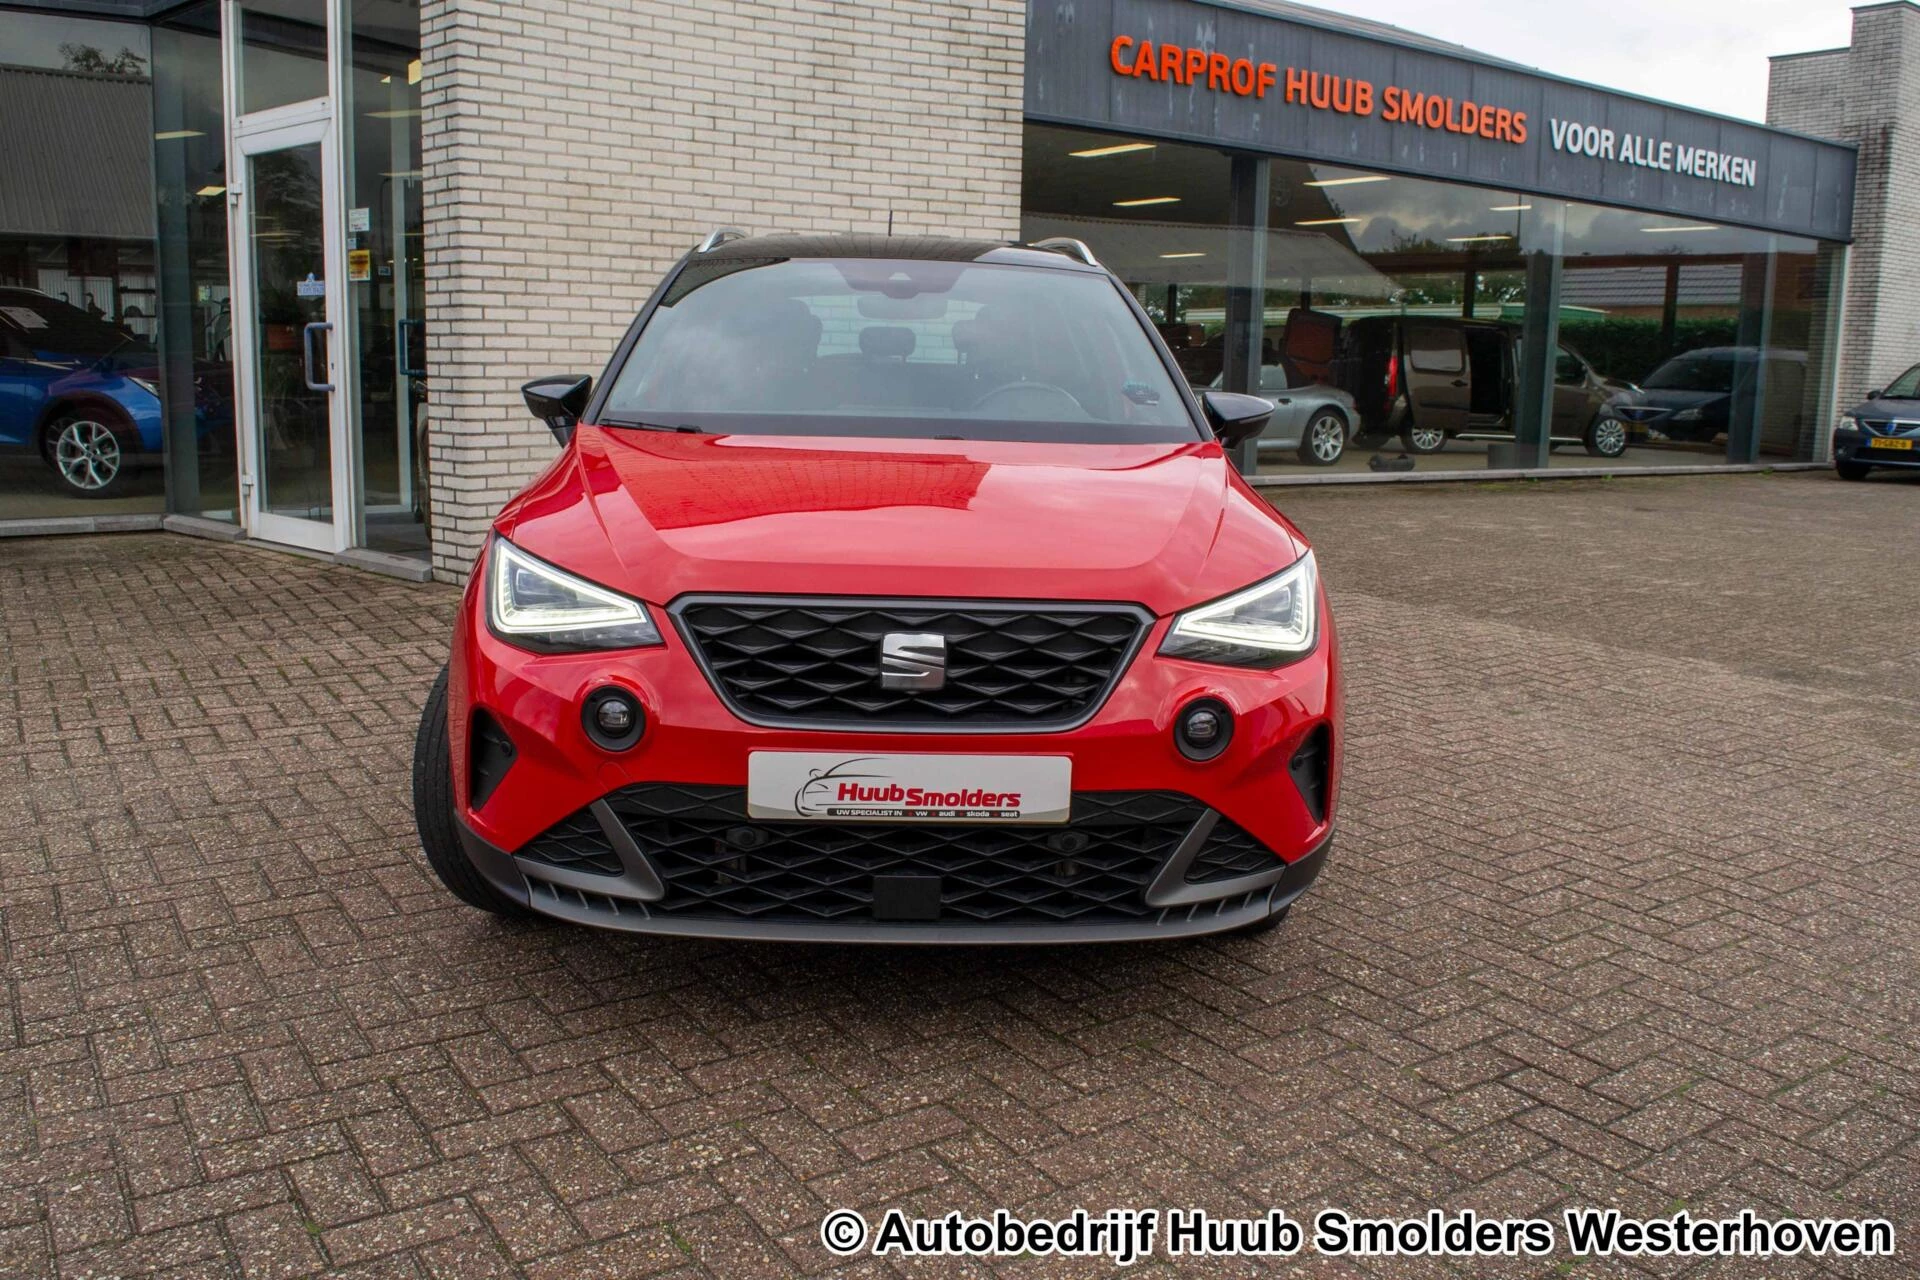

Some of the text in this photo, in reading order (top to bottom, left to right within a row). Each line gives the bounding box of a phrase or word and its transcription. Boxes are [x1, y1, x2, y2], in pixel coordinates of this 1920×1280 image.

[1110, 35, 1528, 144] CARPROF HUUB SMOLDERS
[1550, 118, 1756, 187] VOOR ALLE MERKEN
